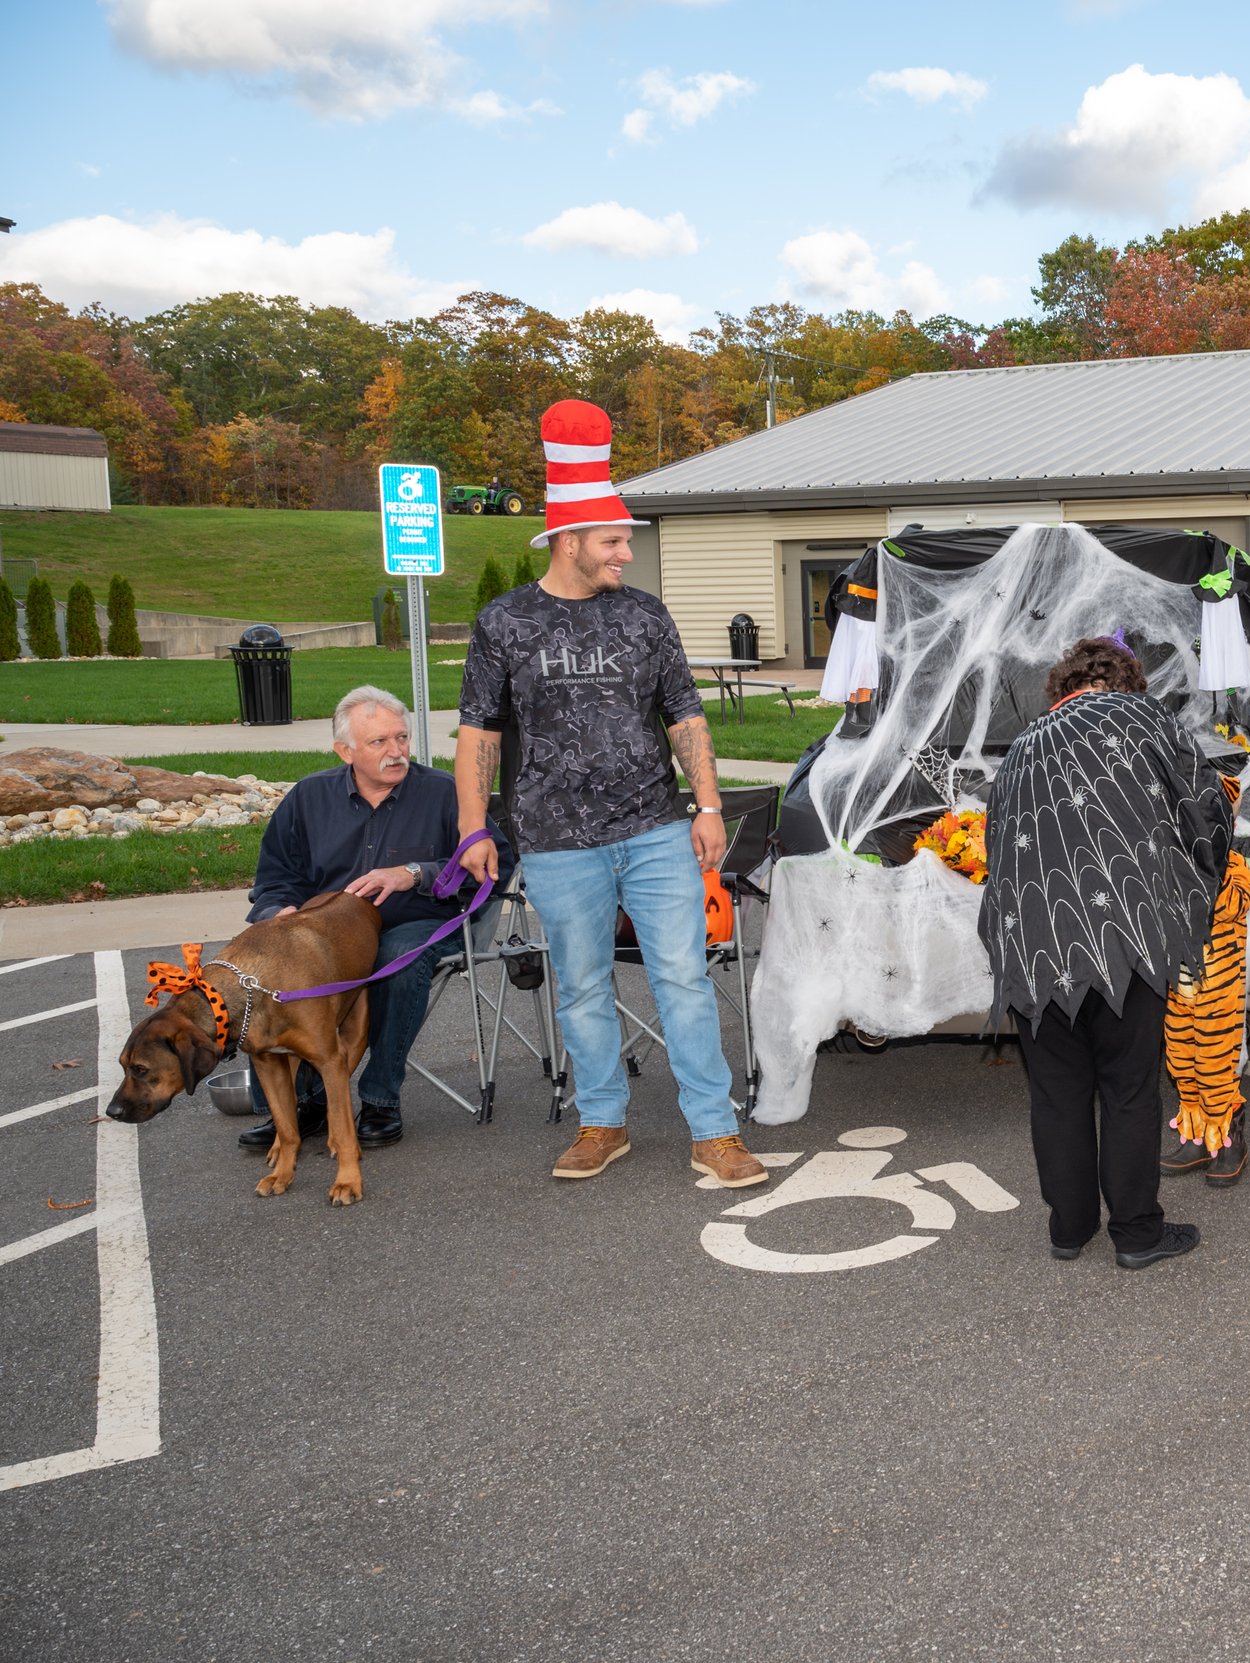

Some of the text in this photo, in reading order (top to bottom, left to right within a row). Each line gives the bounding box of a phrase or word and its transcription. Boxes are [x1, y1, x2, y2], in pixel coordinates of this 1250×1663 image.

[386, 502, 436, 514] RESERVED
[390, 516, 434, 527] PARKING
[545, 677, 596, 686] PERFORMANCE
